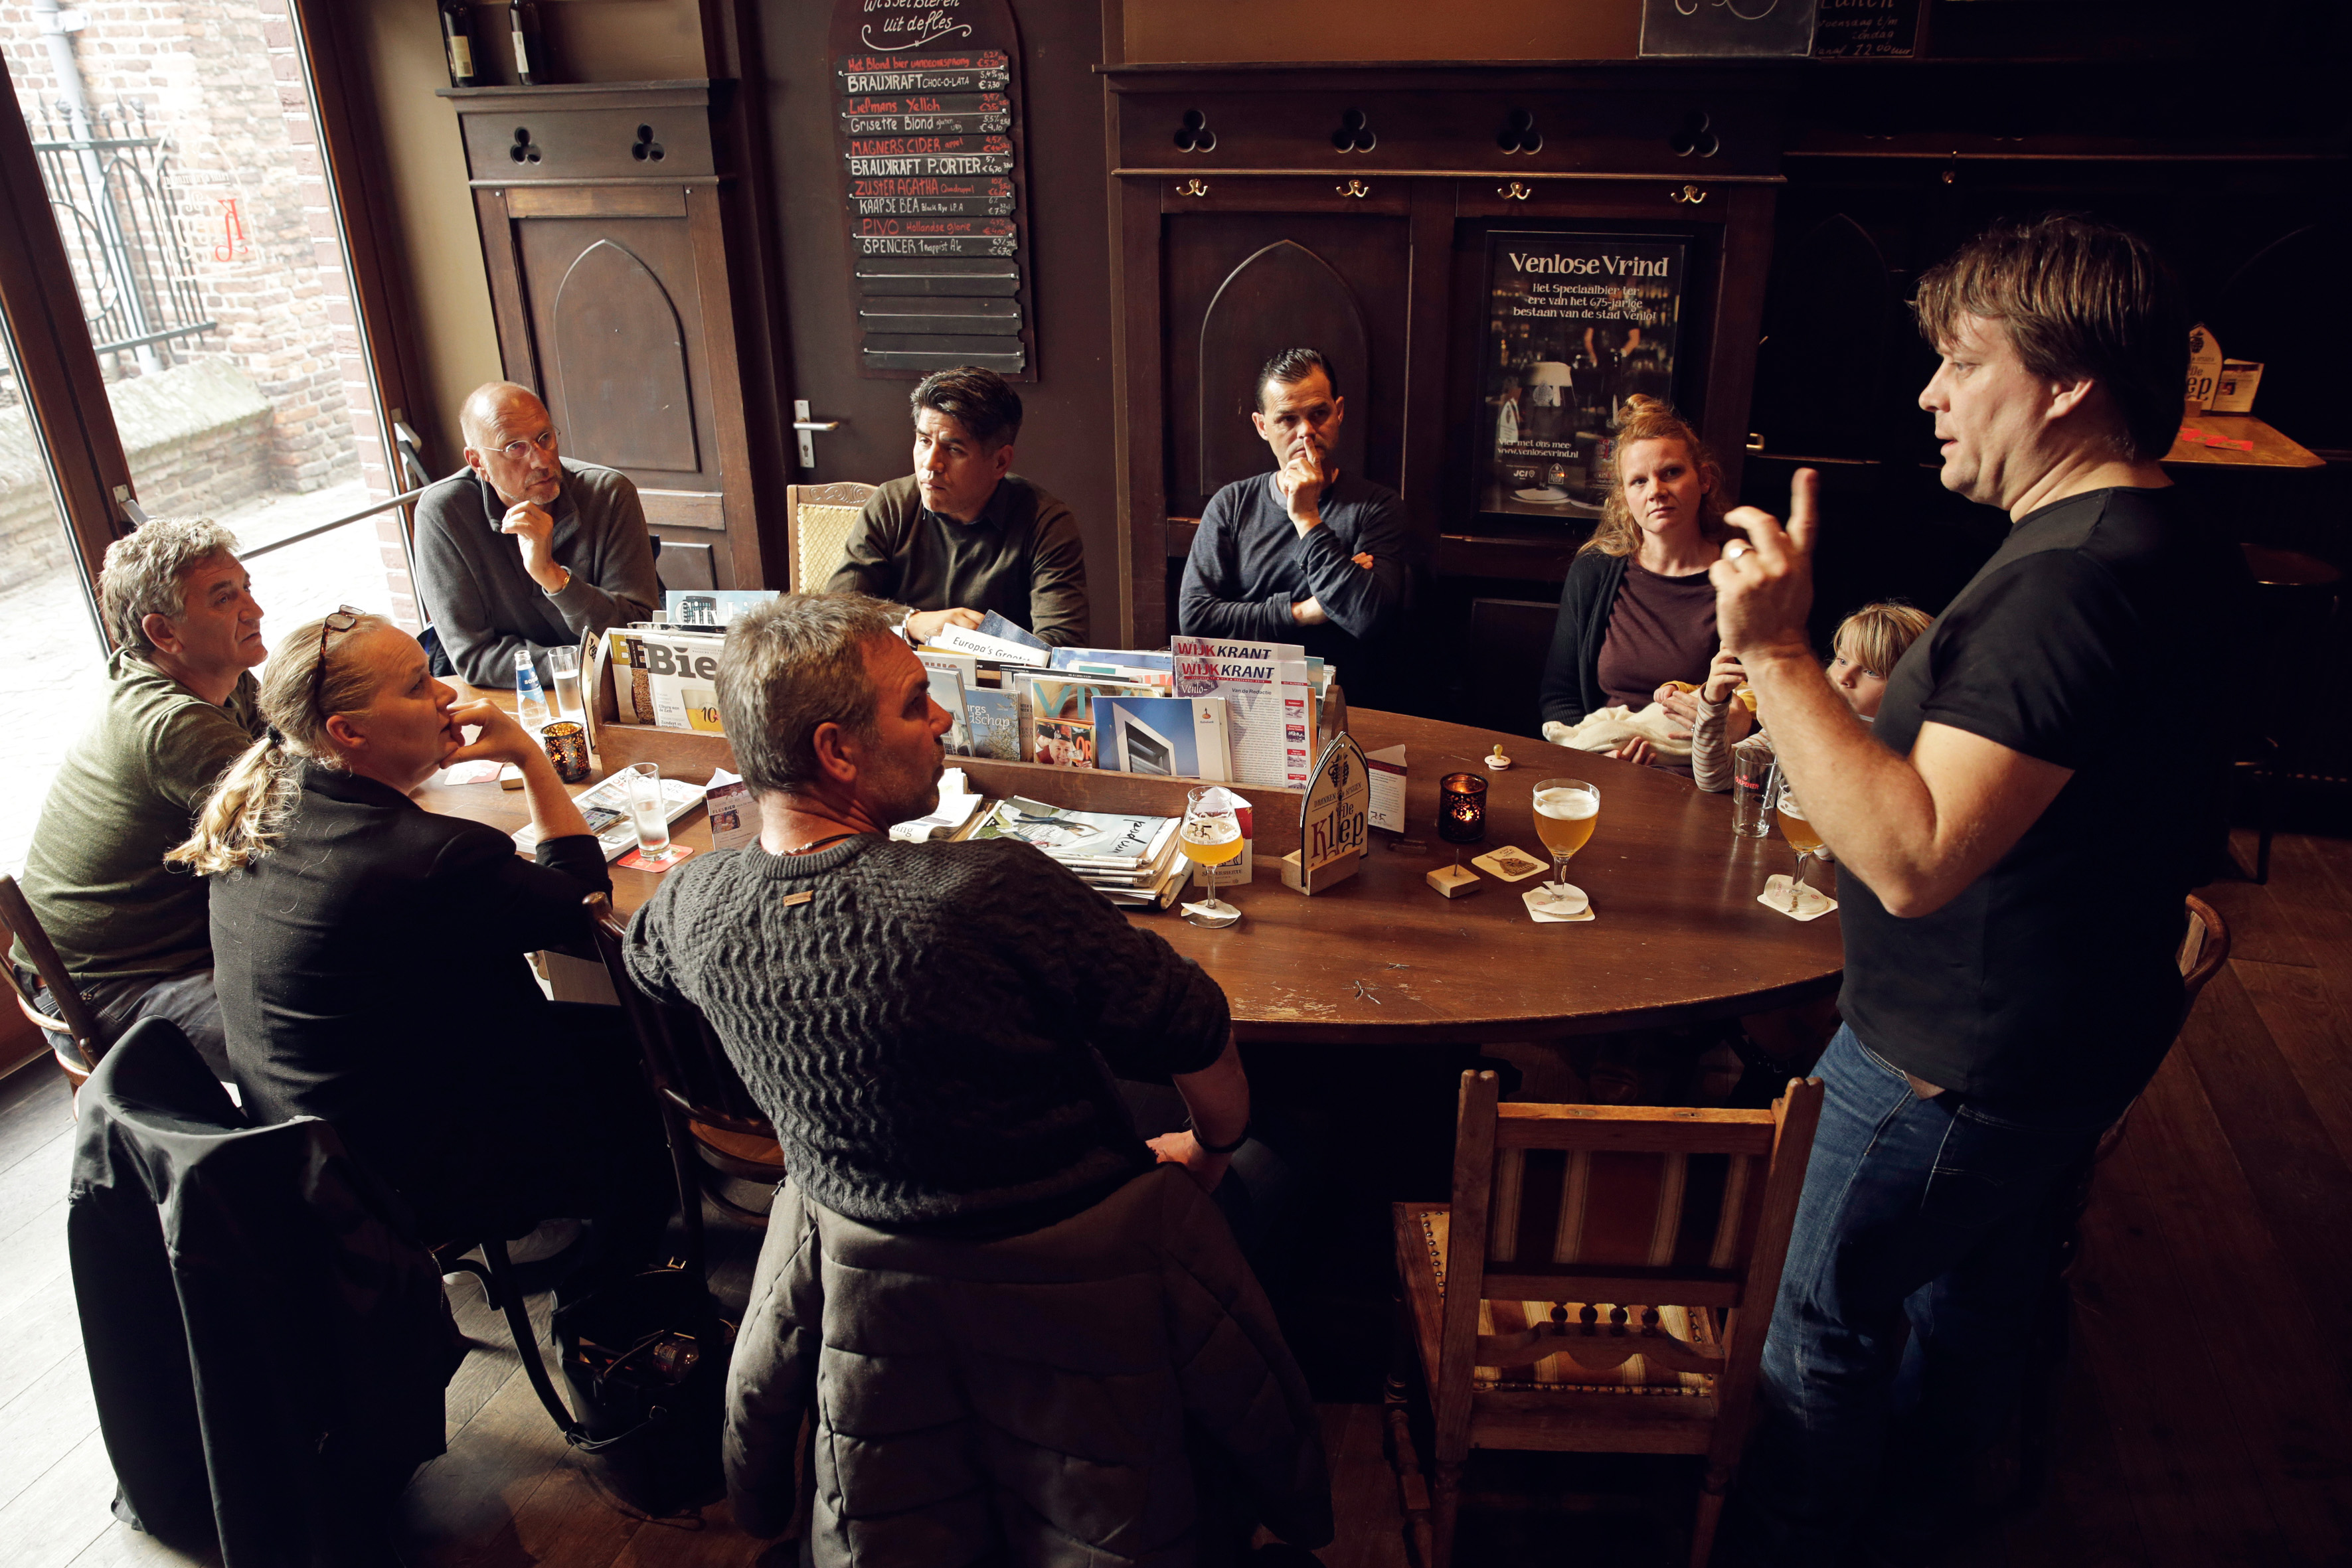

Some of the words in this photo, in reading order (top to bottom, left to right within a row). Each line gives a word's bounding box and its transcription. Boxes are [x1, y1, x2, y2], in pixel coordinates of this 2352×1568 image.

[884, 16, 904, 32] uit
[848, 58, 863, 72] Het
[866, 57, 890, 71] Blond
[922, 76, 969, 88] CHOC-O-LATA
[851, 117, 897, 133] Grisette
[904, 116, 934, 131] Blond
[851, 139, 904, 156] MAGNERS
[906, 137, 941, 153] CIDER
[860, 199, 896, 214] KAAPSE
[899, 198, 920, 213] BEA
[863, 218, 900, 236] PIVO
[906, 222, 945, 232] Hollandse
[863, 239, 916, 254] SPENCER
[1509, 253, 1600, 275] Venlose
[1602, 256, 1669, 277] Vrind
[1533, 283, 1551, 293] Het
[1553, 284, 1621, 298] Speciaalbier
[1622, 286, 1640, 296] ter
[1528, 296, 1546, 305] ere
[1549, 297, 1568, 306] van
[1570, 296, 1588, 306] het
[1590, 297, 1643, 312] 675-jarige
[1513, 307, 1557, 318] bestaan
[1560, 309, 1580, 319] van
[1581, 309, 1594, 319] de
[1596, 310, 1620, 320] stad
[1623, 311, 1657, 321] Venlo!
[675, 600, 722, 625] City
[953, 636, 993, 656] Europa's
[1182, 663, 1275, 679] WIJKKRANT
[713, 804, 736, 814] FLESBIER
[1341, 803, 1354, 819] De
[1311, 811, 1364, 861] Klep
